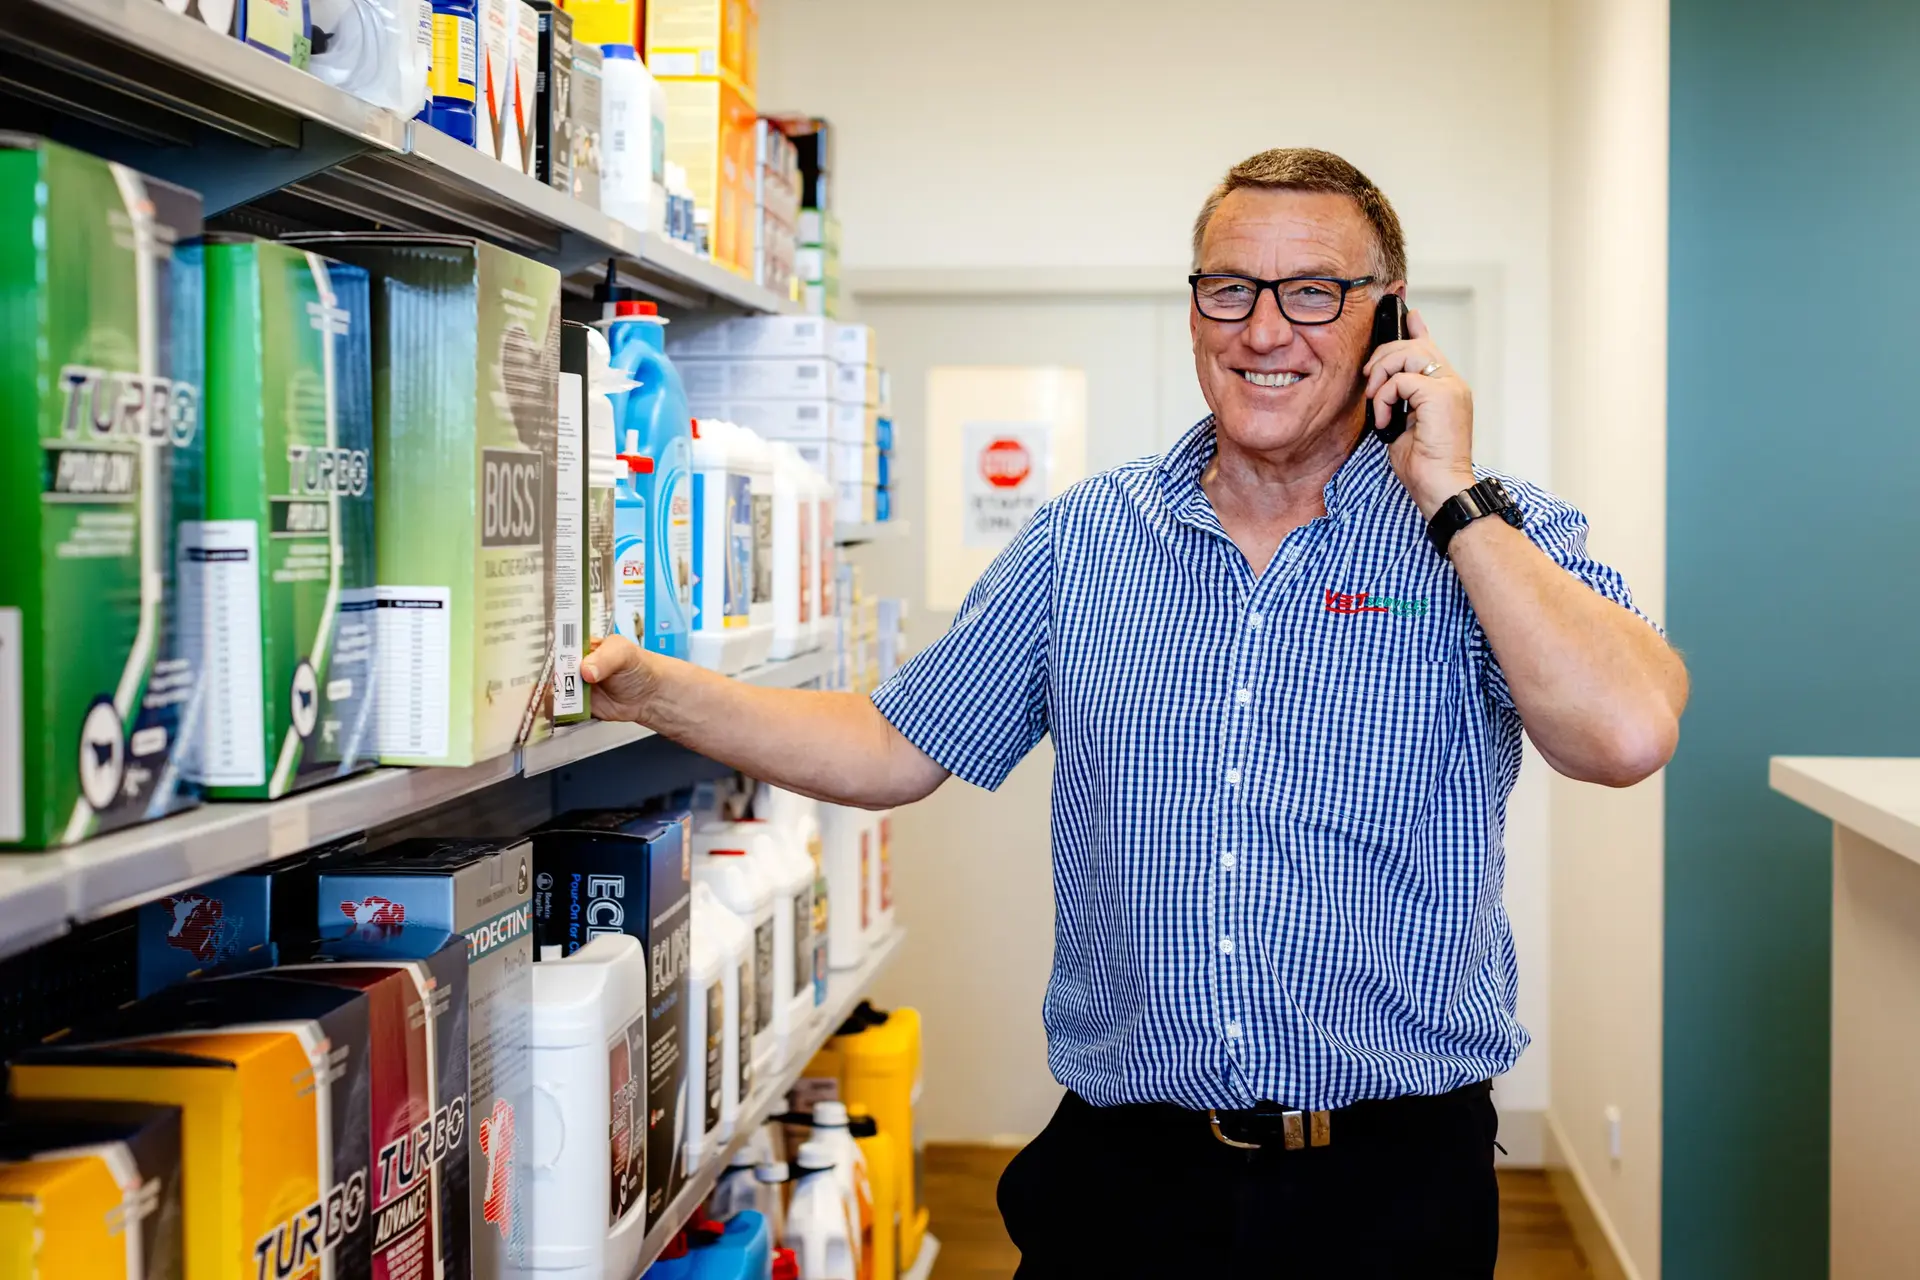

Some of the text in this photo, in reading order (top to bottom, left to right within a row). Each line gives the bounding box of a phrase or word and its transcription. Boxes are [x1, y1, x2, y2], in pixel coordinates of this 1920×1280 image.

[58, 364, 198, 447] TURBO
[286, 444, 368, 497] TURBO
[485, 461, 535, 538] BOSS
[589, 560, 601, 592] SS
[1325, 588, 1429, 611] VET SERVICES
[570, 873, 582, 921] Pour-On
[569, 922, 580, 938] for
[377, 1096, 464, 1203] TURBO
[253, 1172, 367, 1280] TURBO
[375, 1185, 427, 1246] ADVANCE
